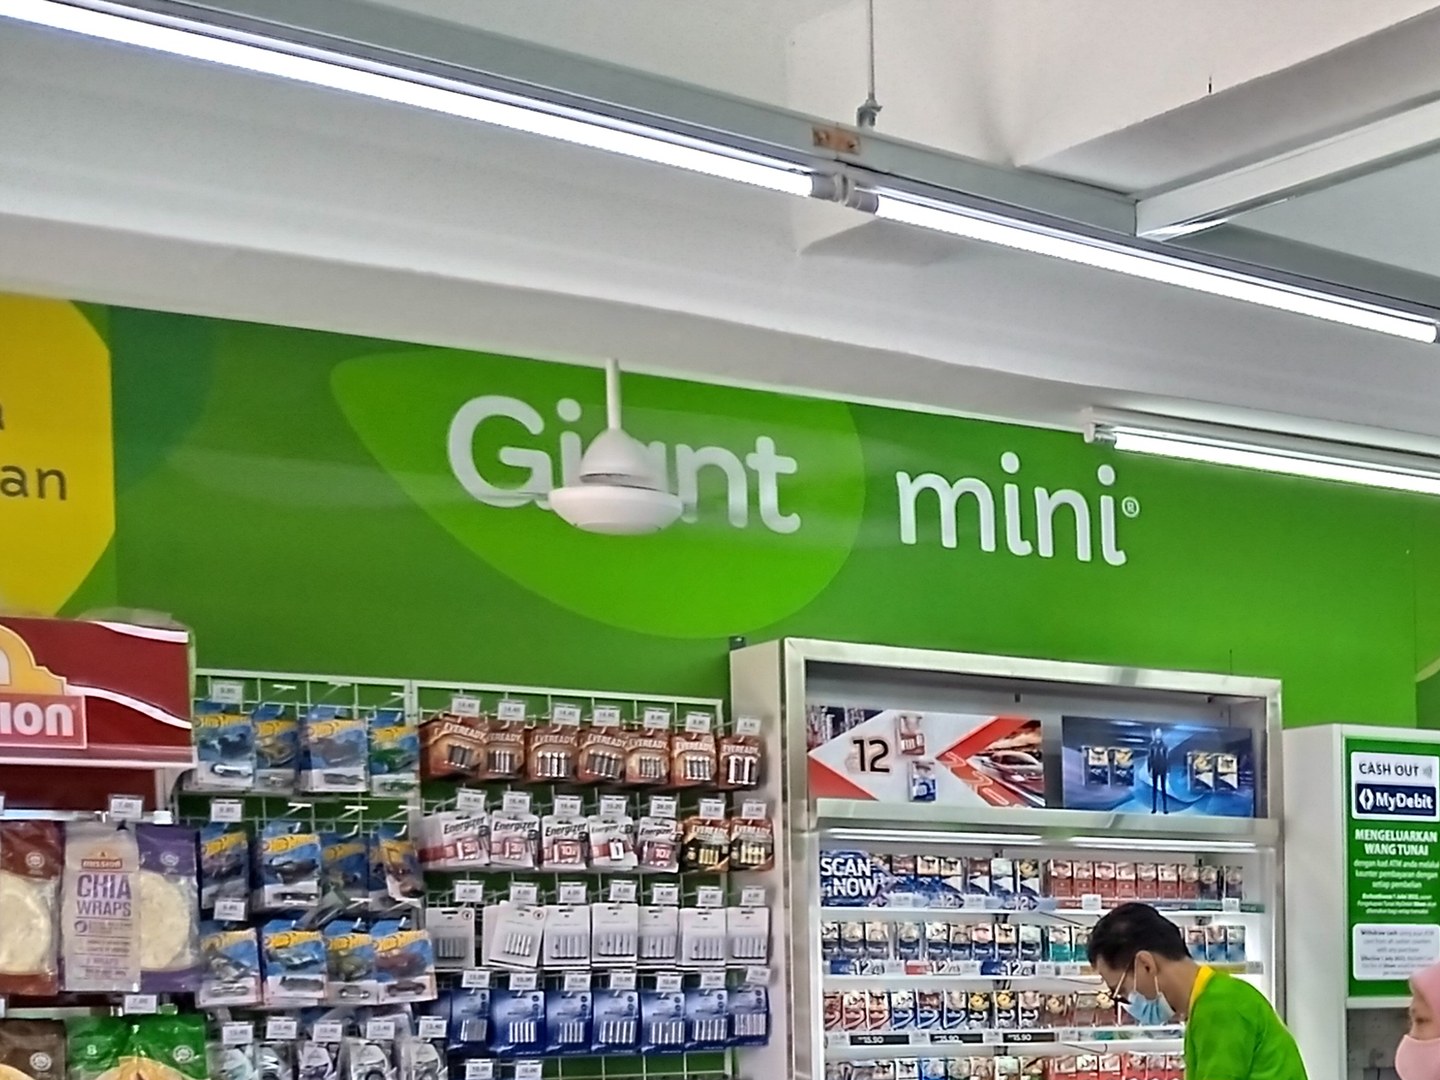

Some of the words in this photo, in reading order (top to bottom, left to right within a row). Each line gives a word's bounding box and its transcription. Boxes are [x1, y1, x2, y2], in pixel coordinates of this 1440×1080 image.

[443, 721, 487, 740] EVEREADY
[534, 733, 576, 745] EVEREADY
[586, 732, 628, 748] EVEREADY
[629, 737, 667, 749] EVEREADY
[675, 741, 715, 751] EVEREADY
[852, 738, 891, 774] 12
[1358, 762, 1391, 776] CASH
[1394, 764, 1420, 777] OUT
[1375, 791, 1434, 811] MyDebit
[443, 815, 486, 836] Energizer
[493, 819, 537, 833] Energizer
[545, 822, 587, 838] Energizer
[639, 825, 673, 836] Energizer
[1354, 829, 1438, 843] MENGELUARKAN
[1364, 842, 1396, 856] WANG
[1396, 843, 1429, 856] TUNAI
[820, 857, 871, 877] SCAN
[76, 873, 132, 900] CHIA
[833, 879, 879, 897] NOW
[76, 900, 132, 918] WRAPS
